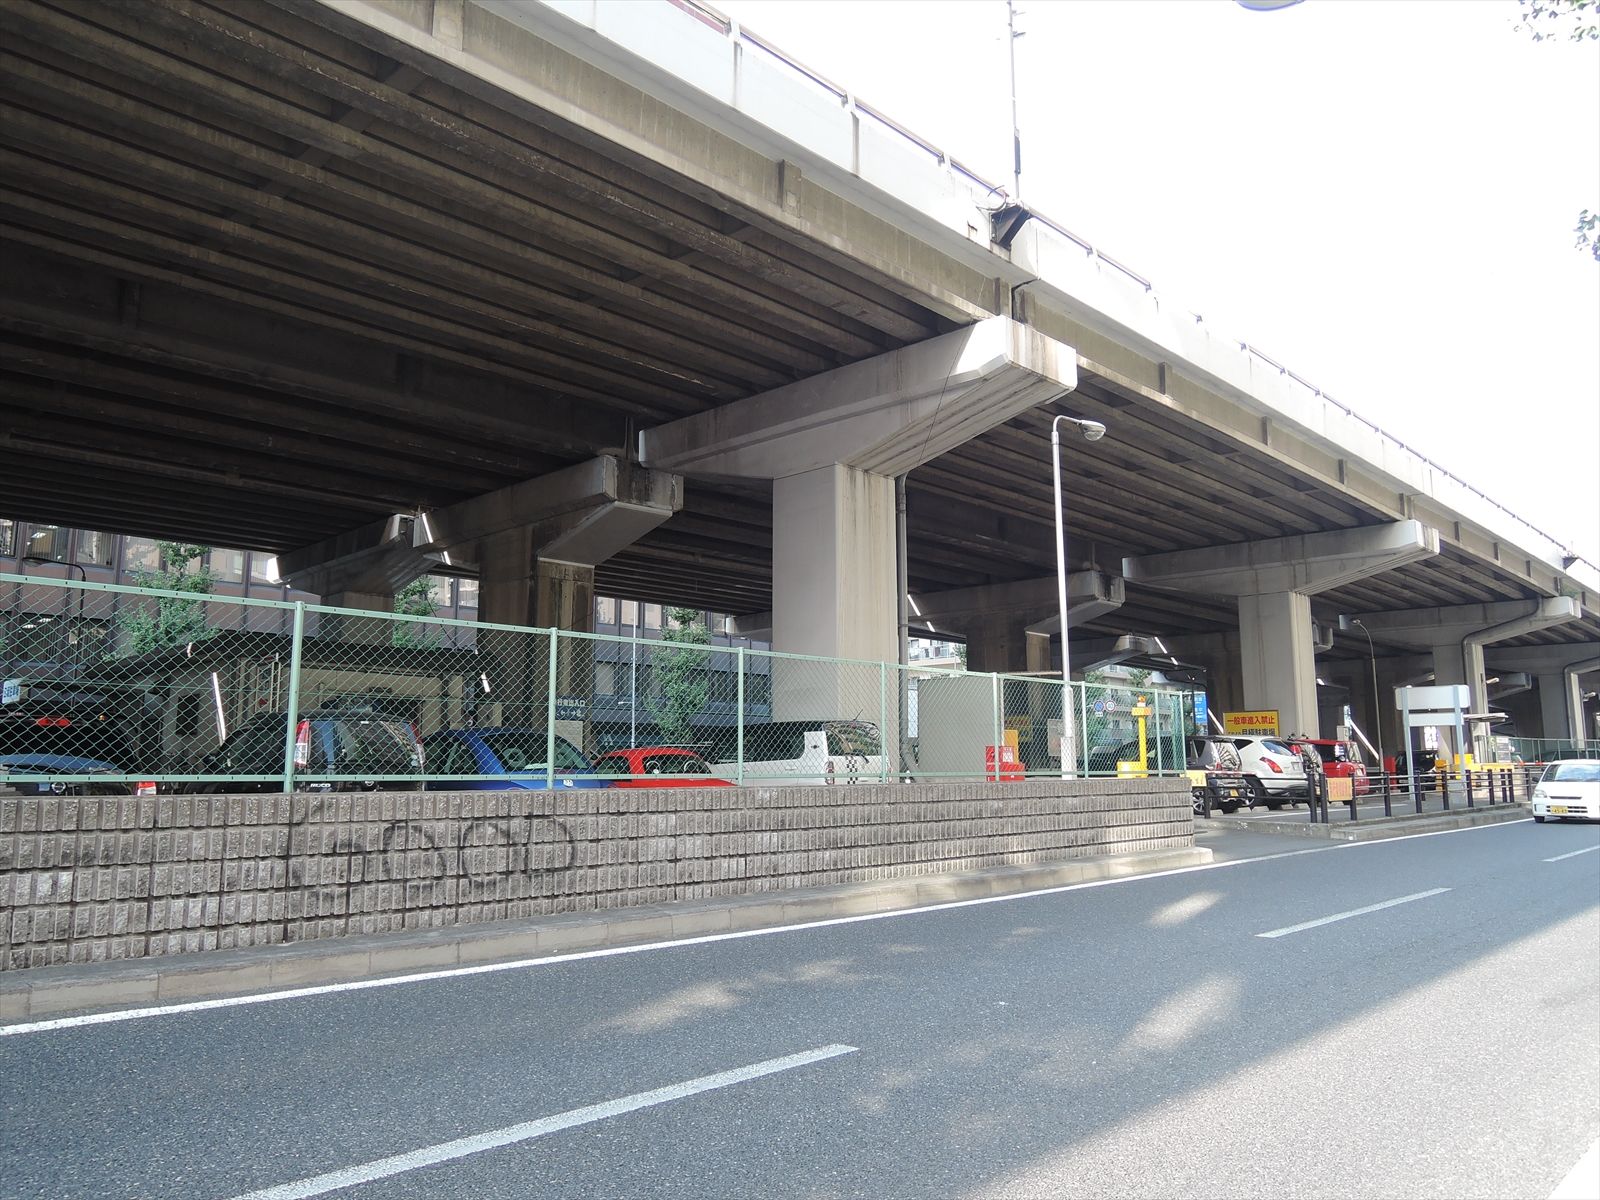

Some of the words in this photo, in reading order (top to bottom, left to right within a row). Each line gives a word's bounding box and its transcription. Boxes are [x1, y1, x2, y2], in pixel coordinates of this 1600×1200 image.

[1227, 715, 1275, 725] 一般車進入禁止
